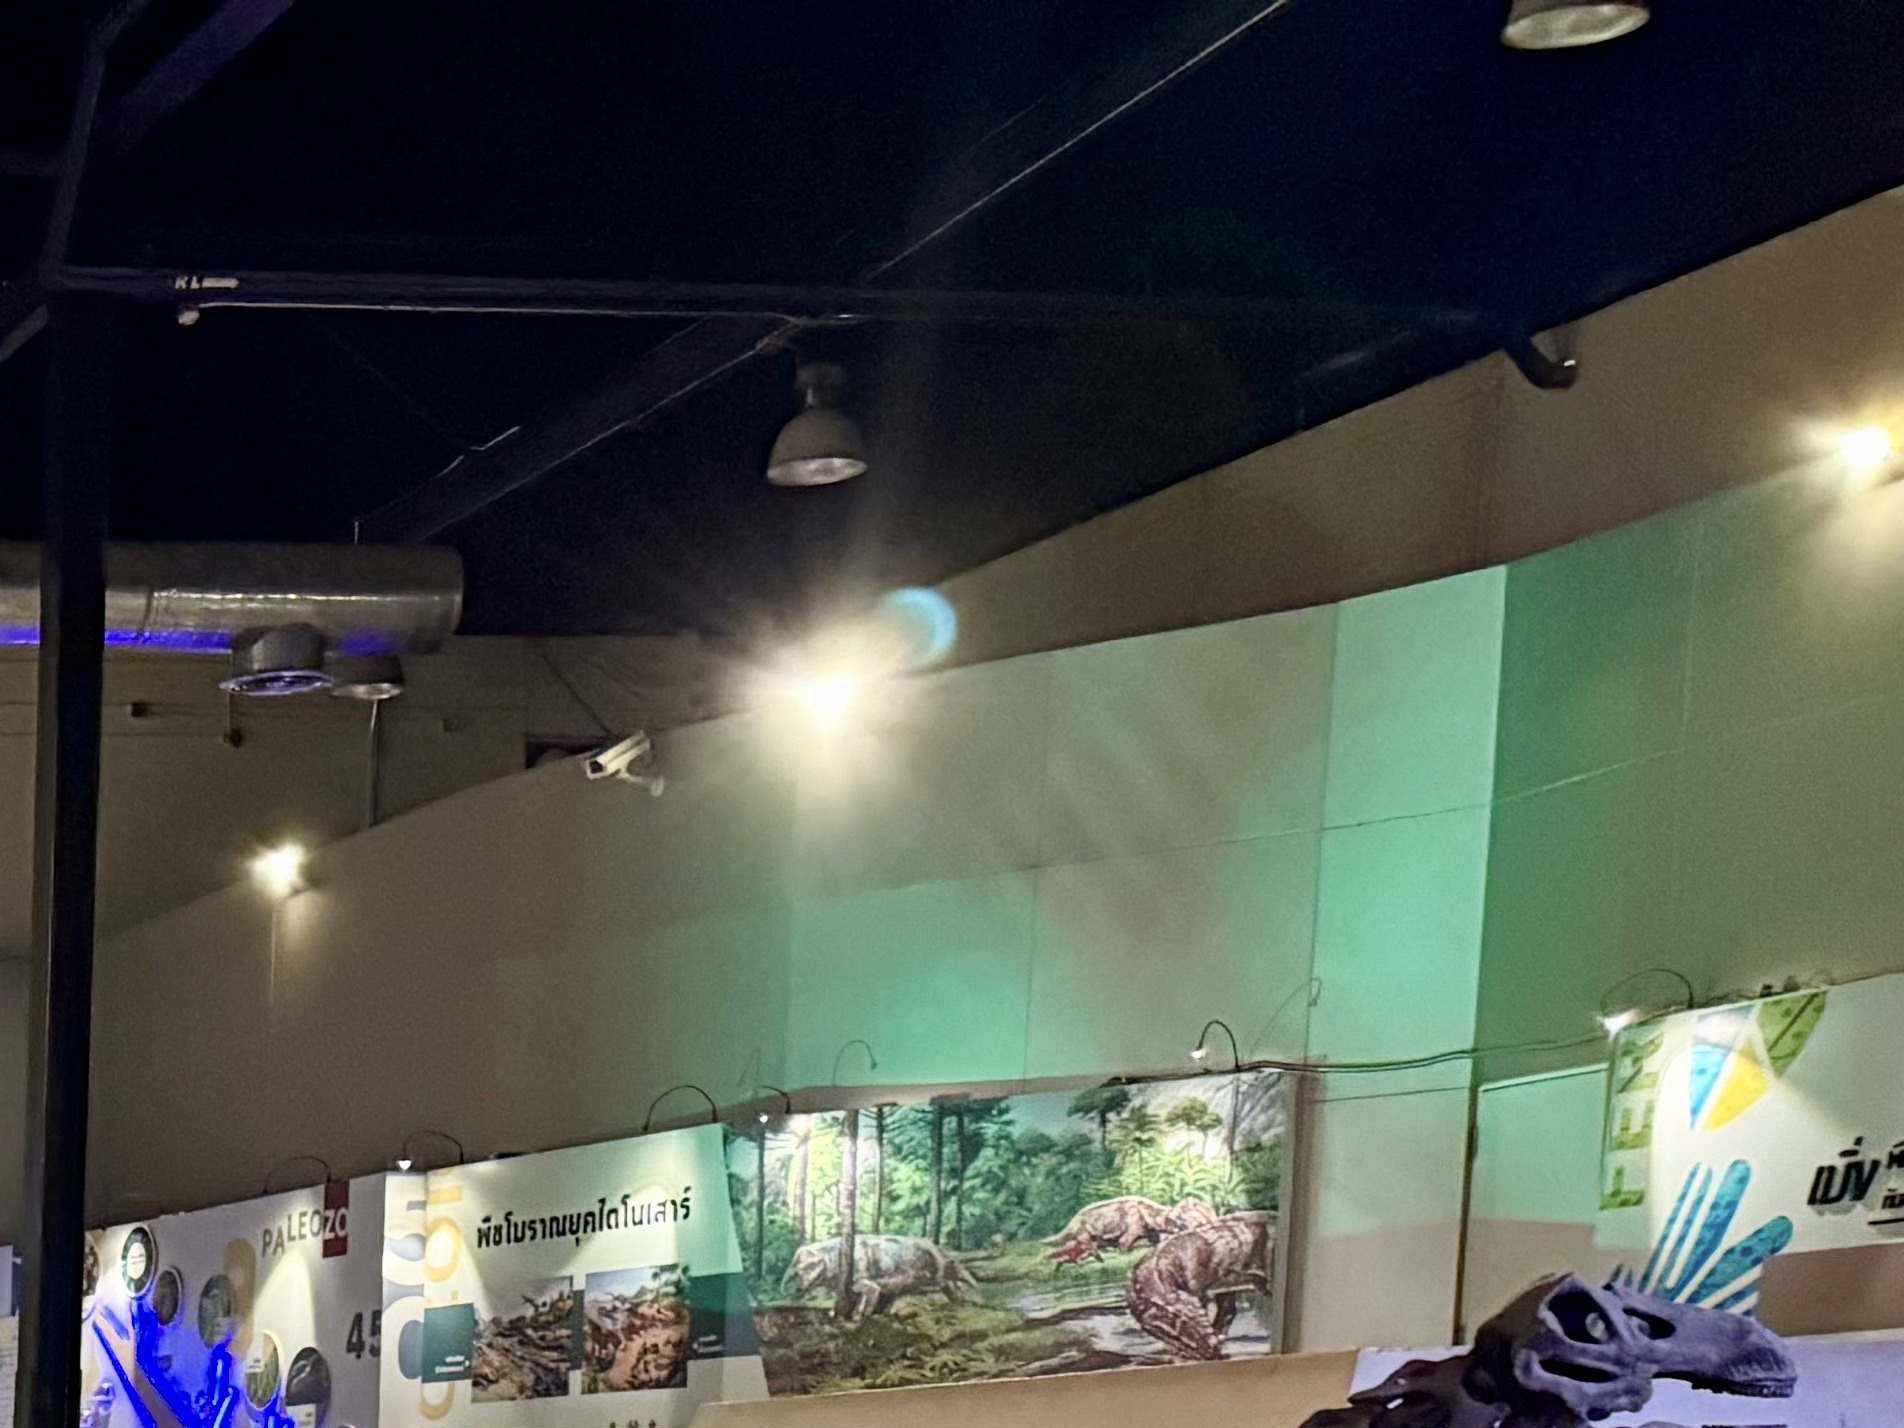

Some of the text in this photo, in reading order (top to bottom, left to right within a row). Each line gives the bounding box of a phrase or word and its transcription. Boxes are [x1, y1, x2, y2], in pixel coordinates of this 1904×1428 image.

[476, 1186, 693, 1249] พืชโบราณยุคไดโนเสาร์
